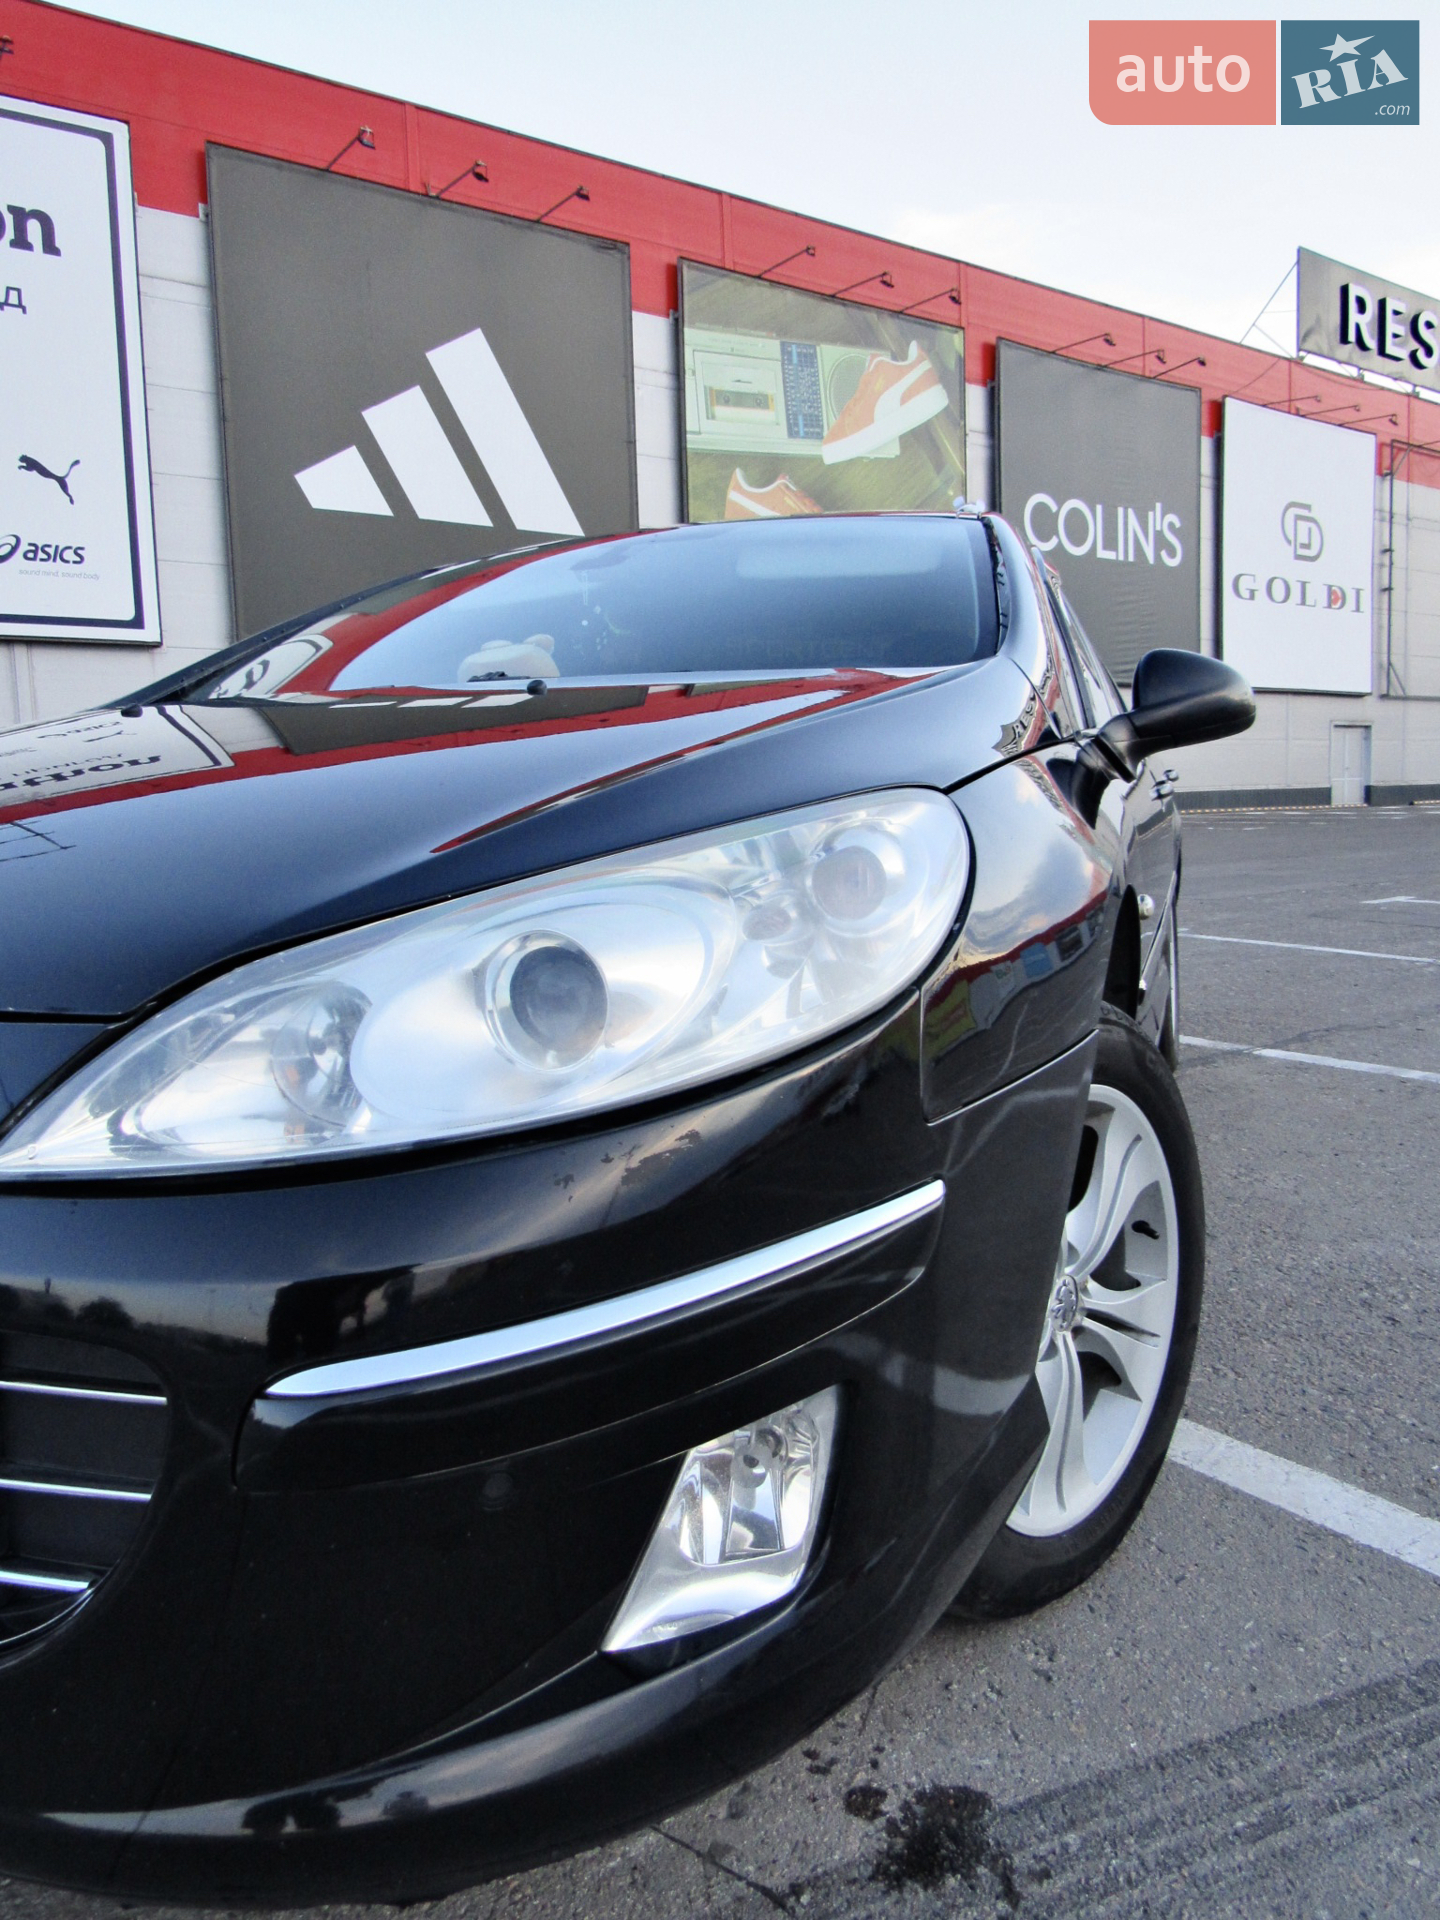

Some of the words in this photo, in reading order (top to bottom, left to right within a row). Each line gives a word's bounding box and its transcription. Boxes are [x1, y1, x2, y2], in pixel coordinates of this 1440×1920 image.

[1339, 282, 1440, 371] RES
[1023, 492, 1183, 567] COLIN'S
[1231, 573, 1365, 614] GOLDI
